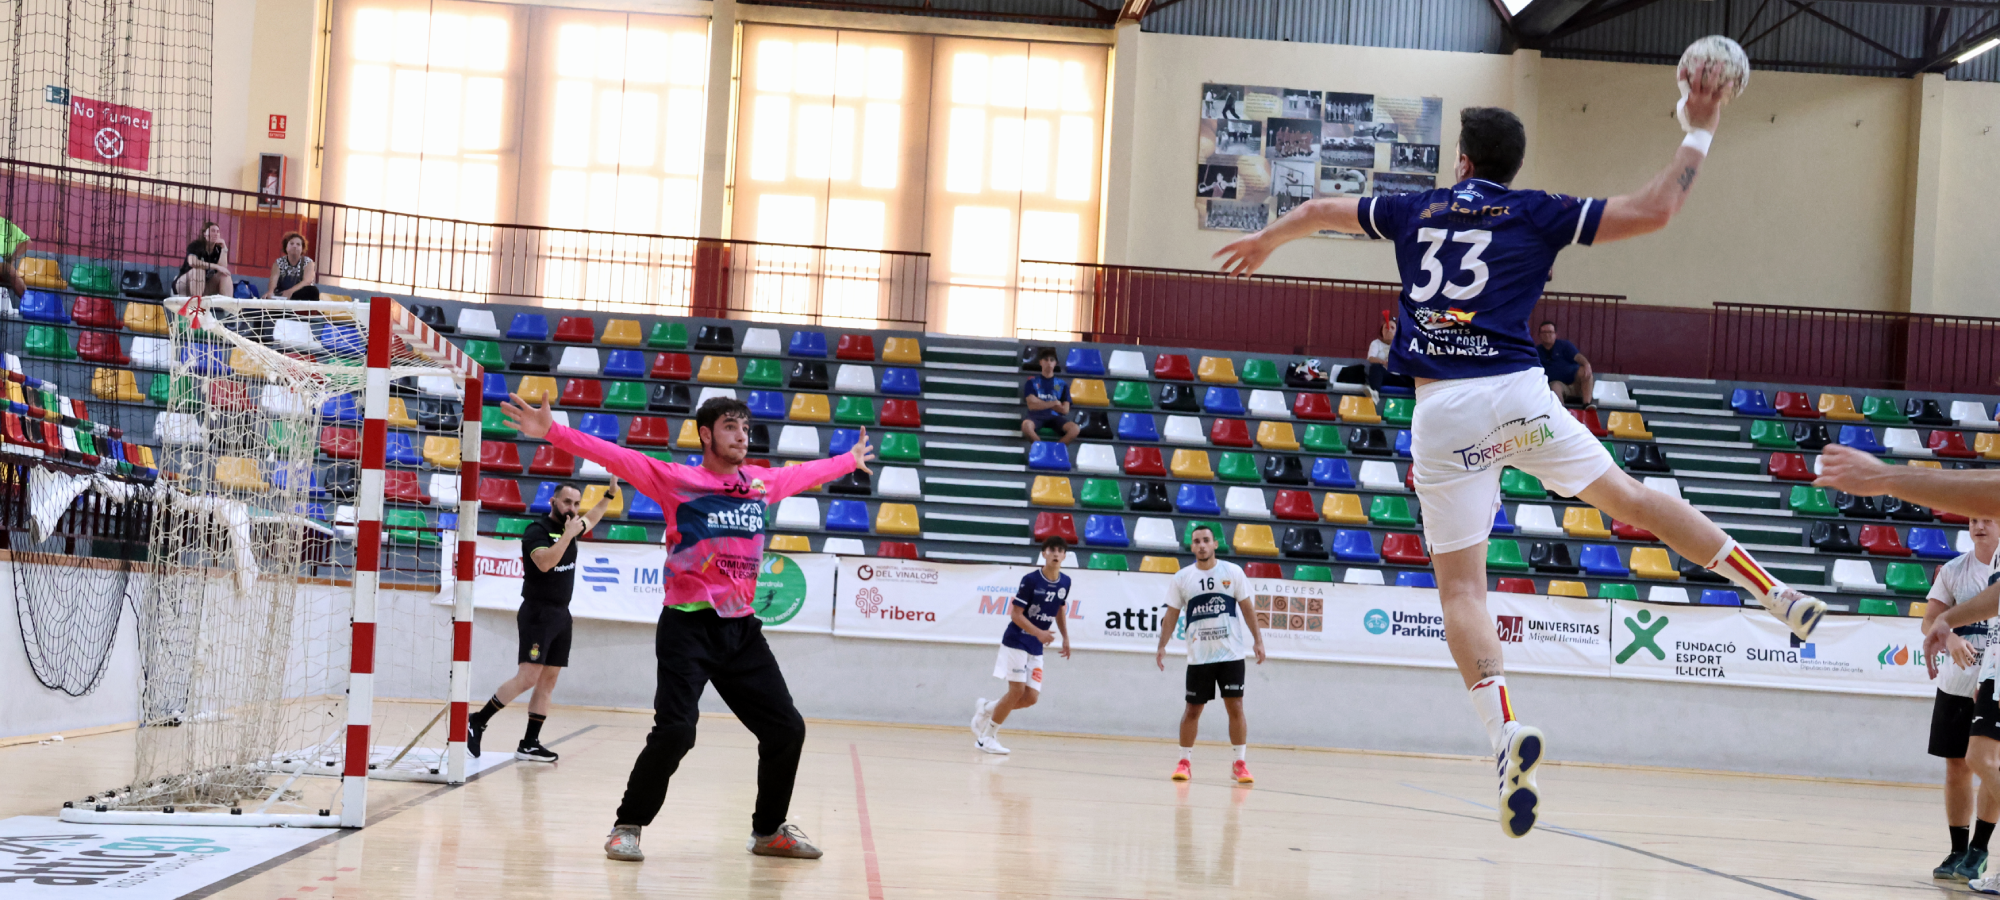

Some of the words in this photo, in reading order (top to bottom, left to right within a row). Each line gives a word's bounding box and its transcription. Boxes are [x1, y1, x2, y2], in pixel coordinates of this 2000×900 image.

[74, 101, 94, 118] No
[102, 107, 149, 130] fumeu
[1409, 227, 1492, 302] 33
[1408, 337, 1424, 354] A.
[707, 508, 763, 532] atticgo
[876, 570, 892, 578] DEL
[896, 571, 938, 580] VINALOPÓ
[634, 586, 663, 594] ELCHE
[1199, 577, 1215, 591] 16
[1254, 584, 1268, 592] LA
[1276, 585, 1324, 595] DEVESA
[1045, 591, 1056, 602] 27
[880, 605, 936, 622] ribera
[1392, 610, 1443, 625] Umbre
[1392, 624, 1447, 641] Parking
[1528, 620, 1600, 635] UNIVERSITAS
[1294, 633, 1322, 641] SCHOOL
[1528, 632, 1557, 643] Miguel
[1558, 634, 1600, 645] Hernández
[1676, 641, 1736, 654] FUNDACIÓ
[1676, 653, 1722, 665] ESPORT
[1746, 647, 1798, 664] suma
[1800, 664, 1830, 672] Diputación
[1822, 659, 1850, 667] tributaria
